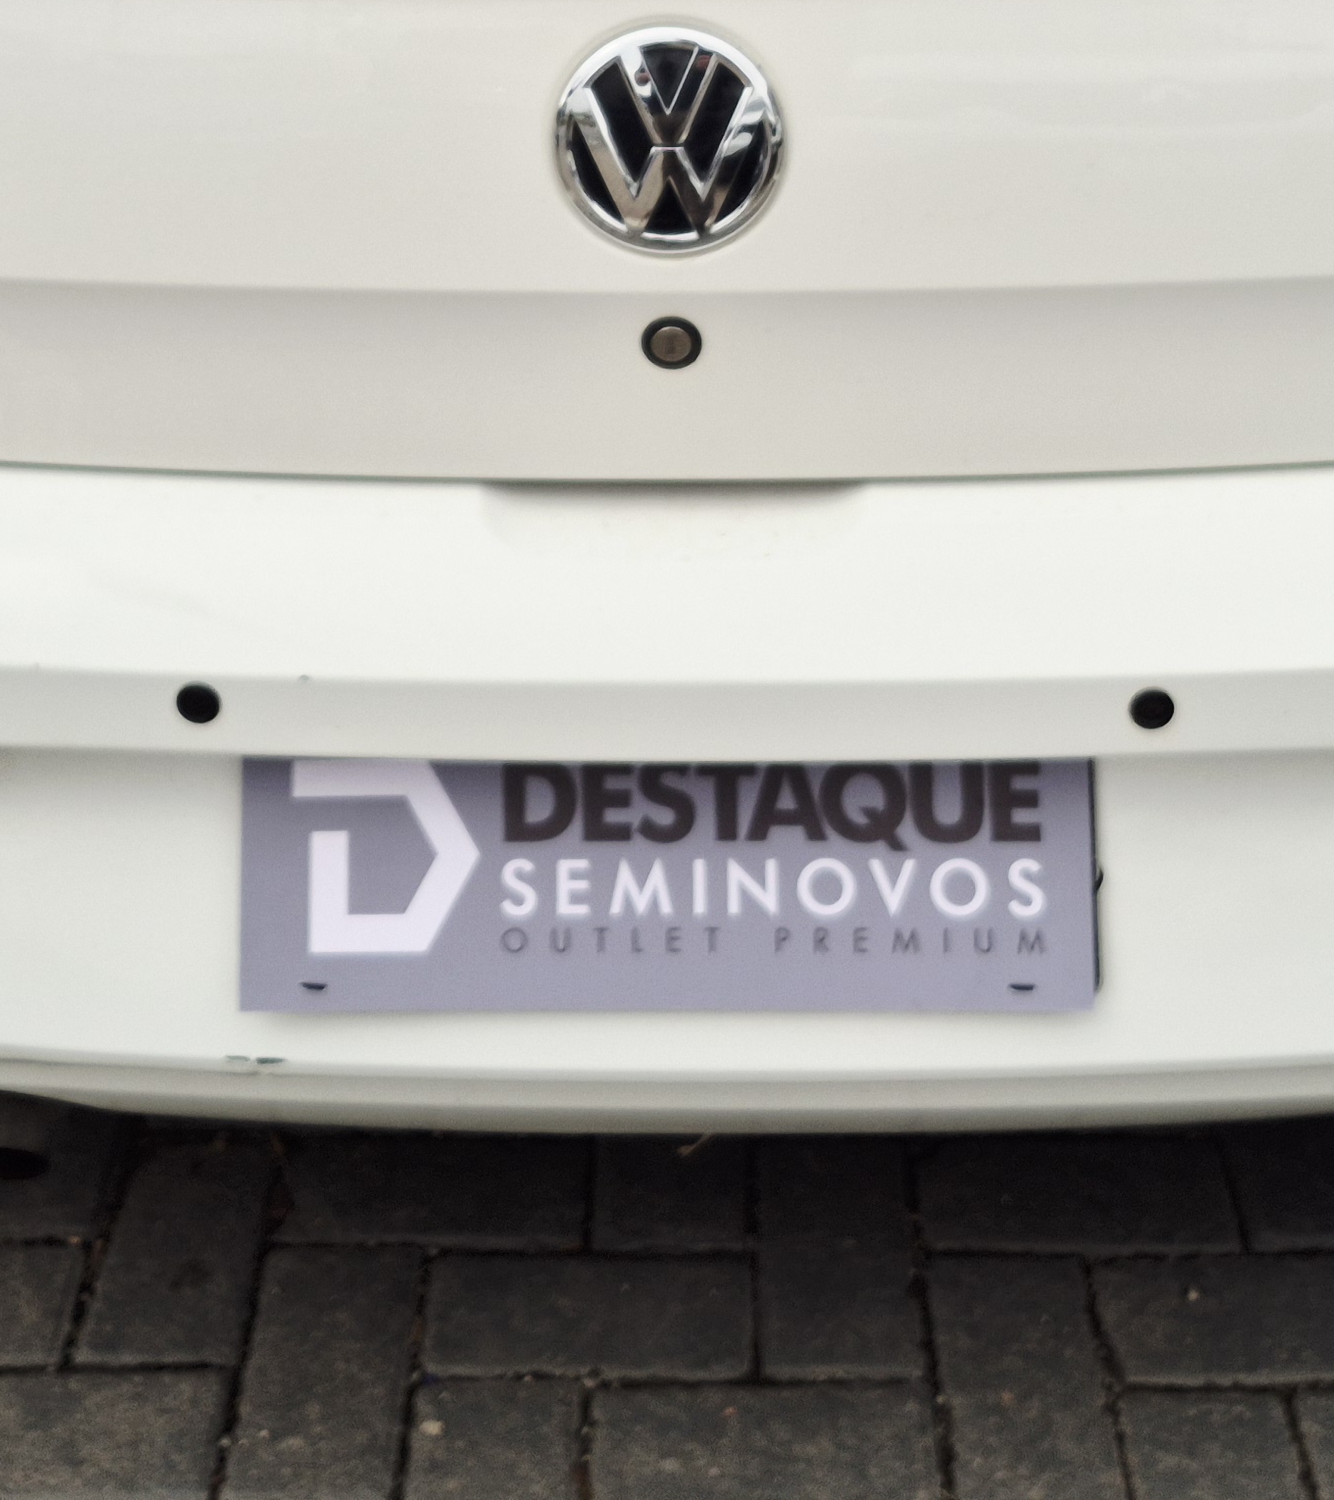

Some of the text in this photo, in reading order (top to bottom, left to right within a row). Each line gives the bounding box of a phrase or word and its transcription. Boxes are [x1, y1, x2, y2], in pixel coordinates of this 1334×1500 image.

[501, 761, 1042, 851] DESTAQUE
[499, 857, 1047, 918] SEMINOVOS
[499, 926, 1047, 954] OUTLET PREMIUM
